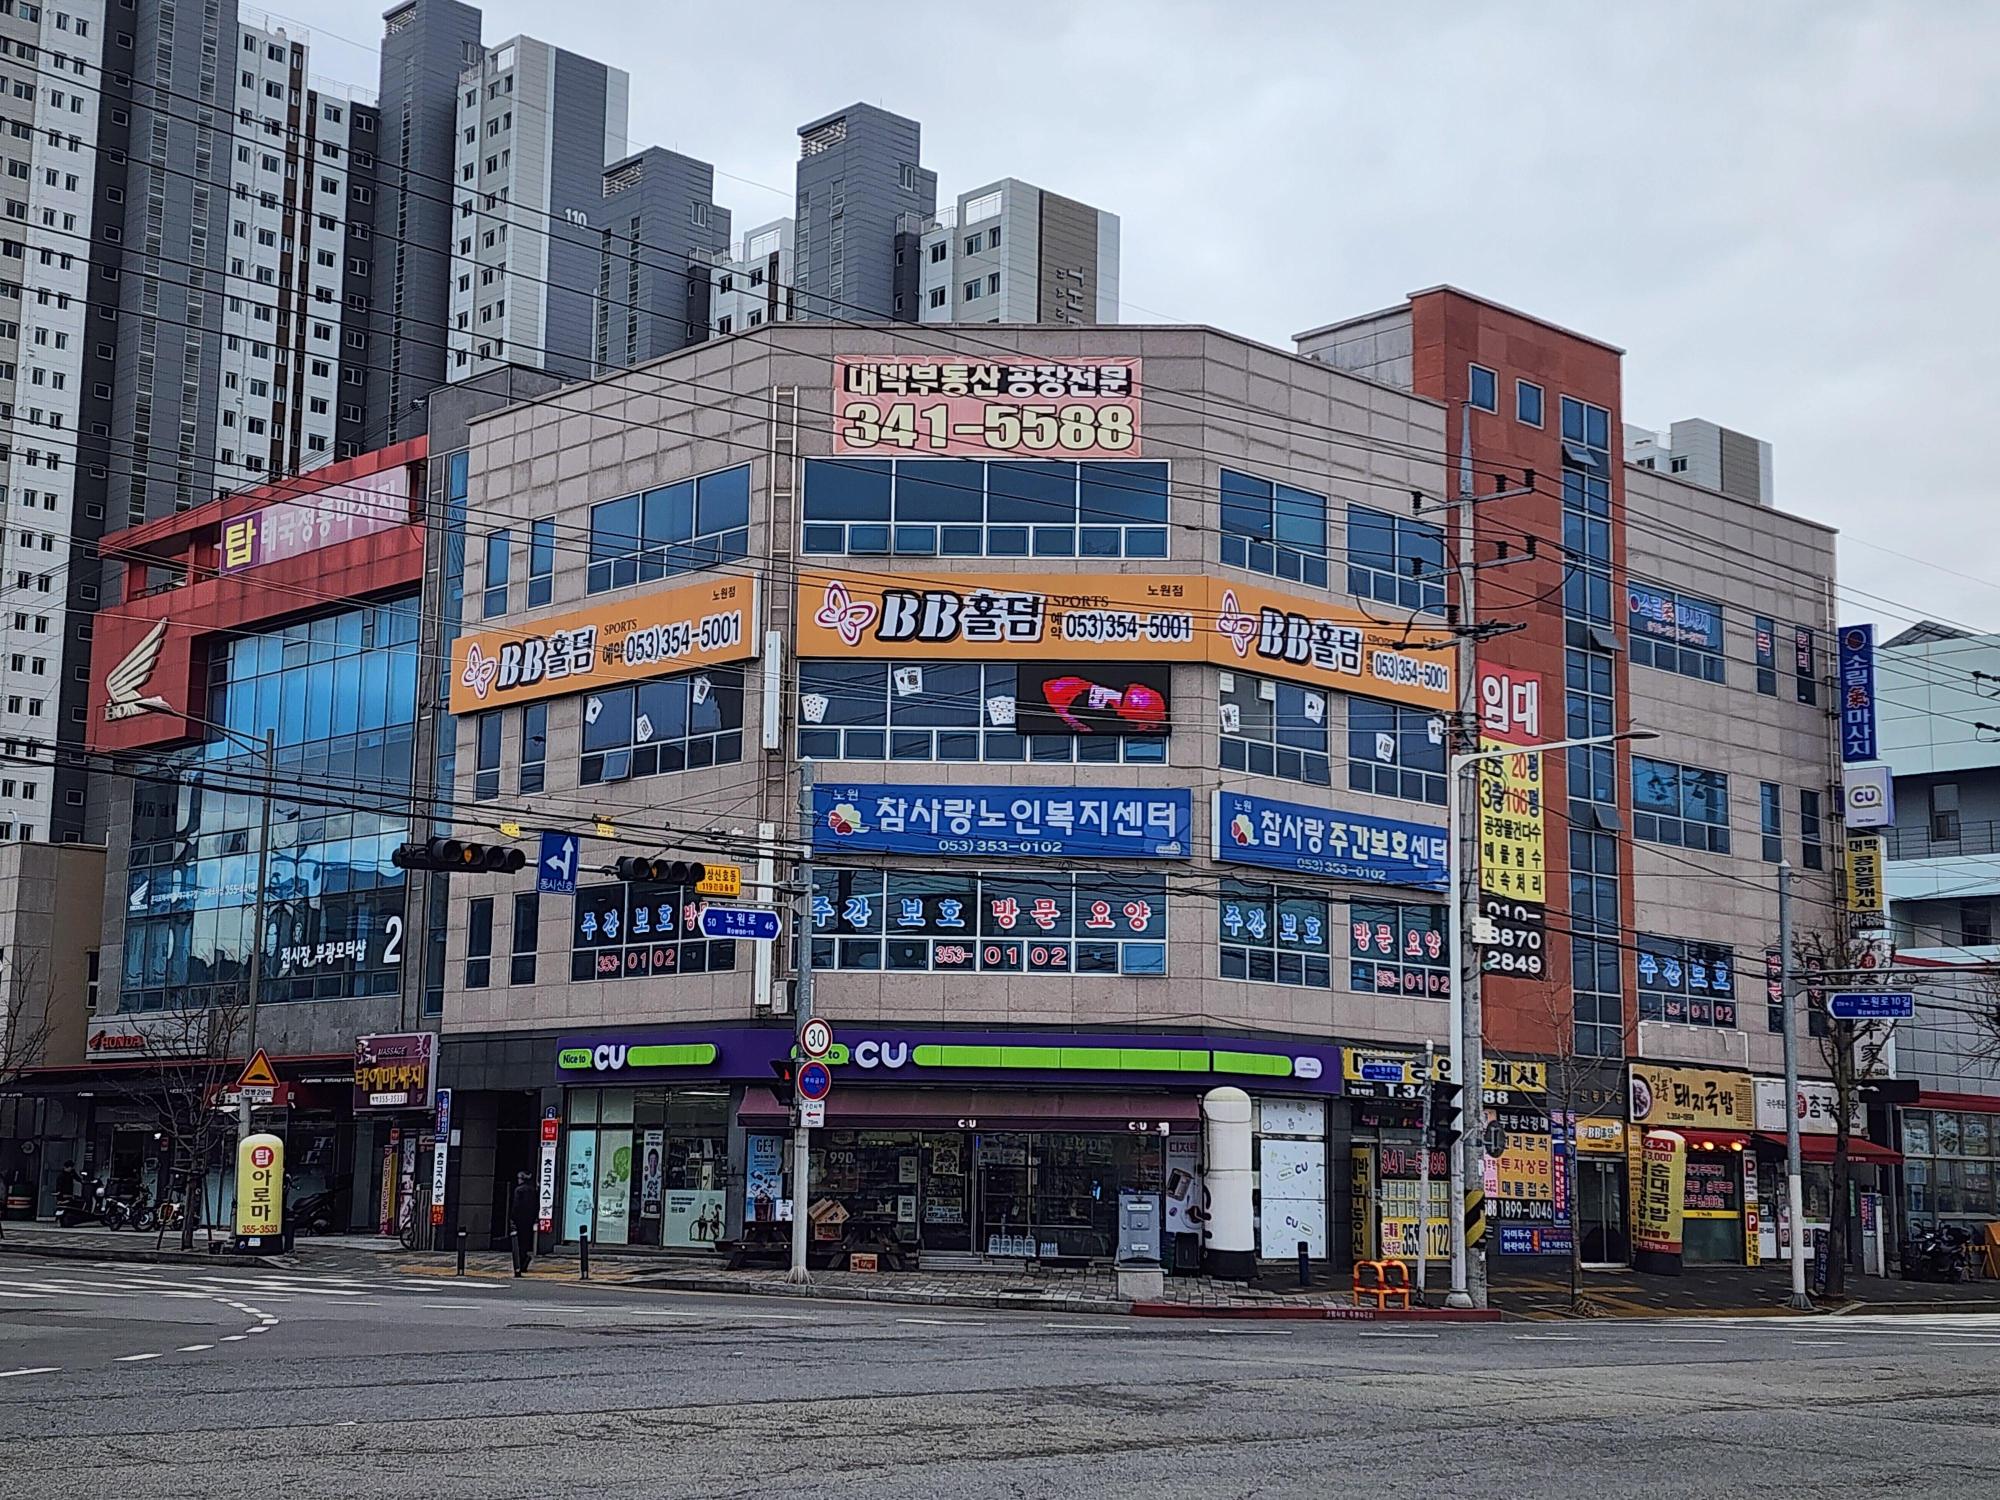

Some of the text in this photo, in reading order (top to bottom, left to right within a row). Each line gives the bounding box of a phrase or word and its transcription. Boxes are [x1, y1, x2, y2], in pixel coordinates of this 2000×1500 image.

[565, 208, 588, 229] 110
[848, 364, 1129, 397] 대박부동산 공장전문
[843, 402, 1134, 450] 341-5588
[225, 518, 256, 568] 탑
[712, 586, 736, 601] 노원점
[1147, 584, 1184, 597] 노원점
[1053, 595, 1109, 607] SPORTS
[877, 590, 1044, 640] BB홀덤
[604, 619, 637, 636] SPORTS
[1065, 612, 1192, 639] 053)354-5001
[626, 612, 741, 663] 053)354-5001
[1257, 605, 1363, 676] BB홀덤
[496, 627, 597, 690] BB홀덤
[1374, 655, 1449, 692] 053)354-5001
[1481, 675, 1538, 737] 임대
[1512, 753, 1539, 782] 20평
[833, 789, 859, 800] 노원
[1854, 791, 1876, 803] CU
[1234, 800, 1252, 813] 노원
[876, 797, 1176, 837] 참사랑노인복지센터
[938, 839, 1062, 853] 053)353-0102
[1260, 809, 1448, 871] 참사랑 주간보호센터
[1296, 857, 1387, 881] 053)353-0102
[540, 878, 574, 893] 동시신호
[1484, 868, 1541, 895] 신속처리
[1854, 856, 1877, 908] 공인중개사
[725, 912, 757, 926] 노원로
[812, 896, 1151, 932] 주간 보호 방문 요양
[1487, 901, 1541, 921] 010-
[581, 908, 619, 941] 주간
[632, 904, 674, 934] 보호
[707, 918, 717, 927] 50
[764, 921, 774, 931] 46
[1223, 905, 1442, 959] 주간 보호 방문 요양
[382, 916, 403, 964] 2
[280, 939, 367, 969] 전시장 부광모터샵
[934, 946, 1067, 965] 353-0102
[1485, 951, 1541, 974] 2849
[1639, 953, 1682, 987] 주간
[1689, 958, 1731, 990] 보호
[1861, 996, 1911, 1007] 노원로10길
[808, 1029, 825, 1048] 30
[378, 1046, 407, 1056] MASSAGE
[563, 1045, 626, 1071] Nice to CU
[828, 1040, 908, 1069] to CU
[257, 1089, 272, 1097] 20m
[1673, 1081, 1734, 1116] 돼지국밥
[958, 1120, 976, 1128] CU
[1128, 1121, 1147, 1130] CU
[1499, 1114, 1548, 1131] 부동산경매
[756, 1139, 775, 1153] GET
[255, 1149, 271, 1166] 탑
[1382, 1149, 1447, 1175] 341-588
[1501, 1158, 1548, 1174] 투자상담
[1295, 1162, 1309, 1174] CU
[1745, 1160, 1756, 1178] P
[251, 1170, 272, 1222] 아로마
[1501, 1181, 1549, 1198] 매물접수
[1650, 1163, 1671, 1222] 순대국밥
[1500, 1200, 1552, 1219] 1899-0046
[242, 1225, 278, 1234] 355-3533
[1286, 1215, 1299, 1228] CU
[1748, 1215, 1757, 1230] P
